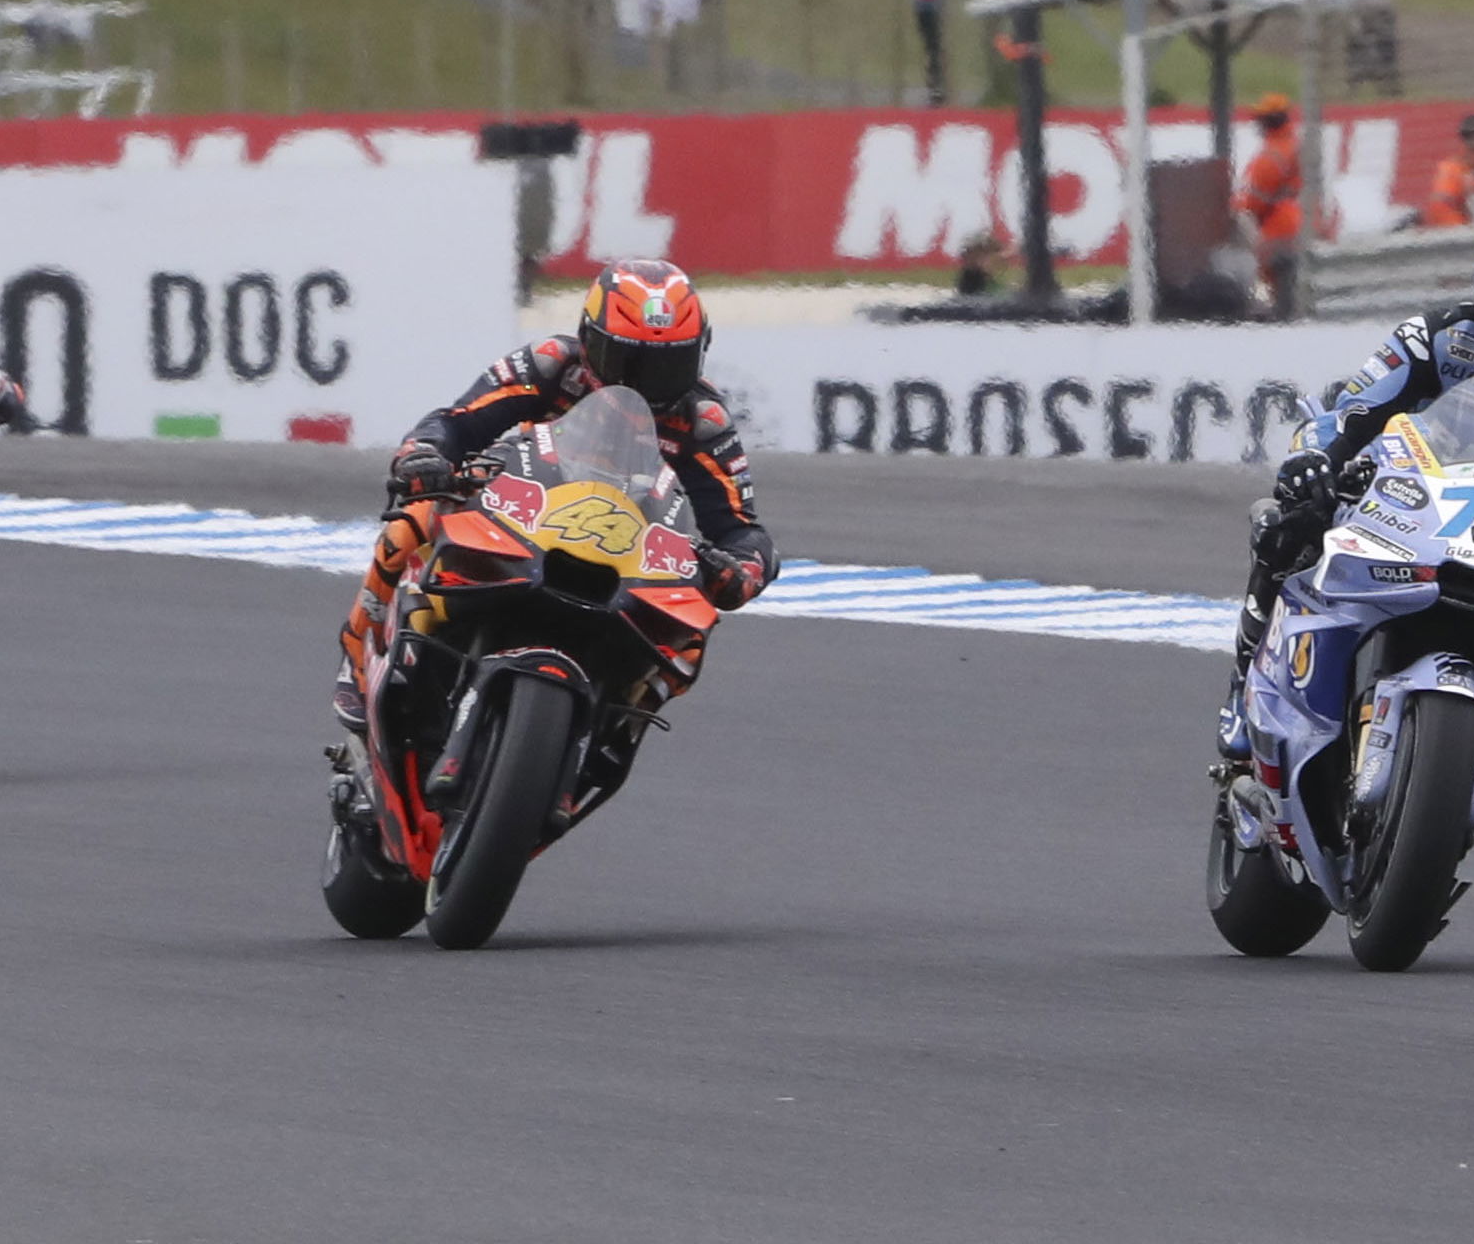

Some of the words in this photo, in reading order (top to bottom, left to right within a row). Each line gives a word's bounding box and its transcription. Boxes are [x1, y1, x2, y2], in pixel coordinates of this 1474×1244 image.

[836, 117, 1414, 260] MOL
[150, 267, 352, 386] DOC
[533, 423, 555, 456] MOTUL
[813, 375, 1349, 462] PROSECC
[540, 496, 643, 555] 44
[1372, 566, 1412, 580] BOLD
